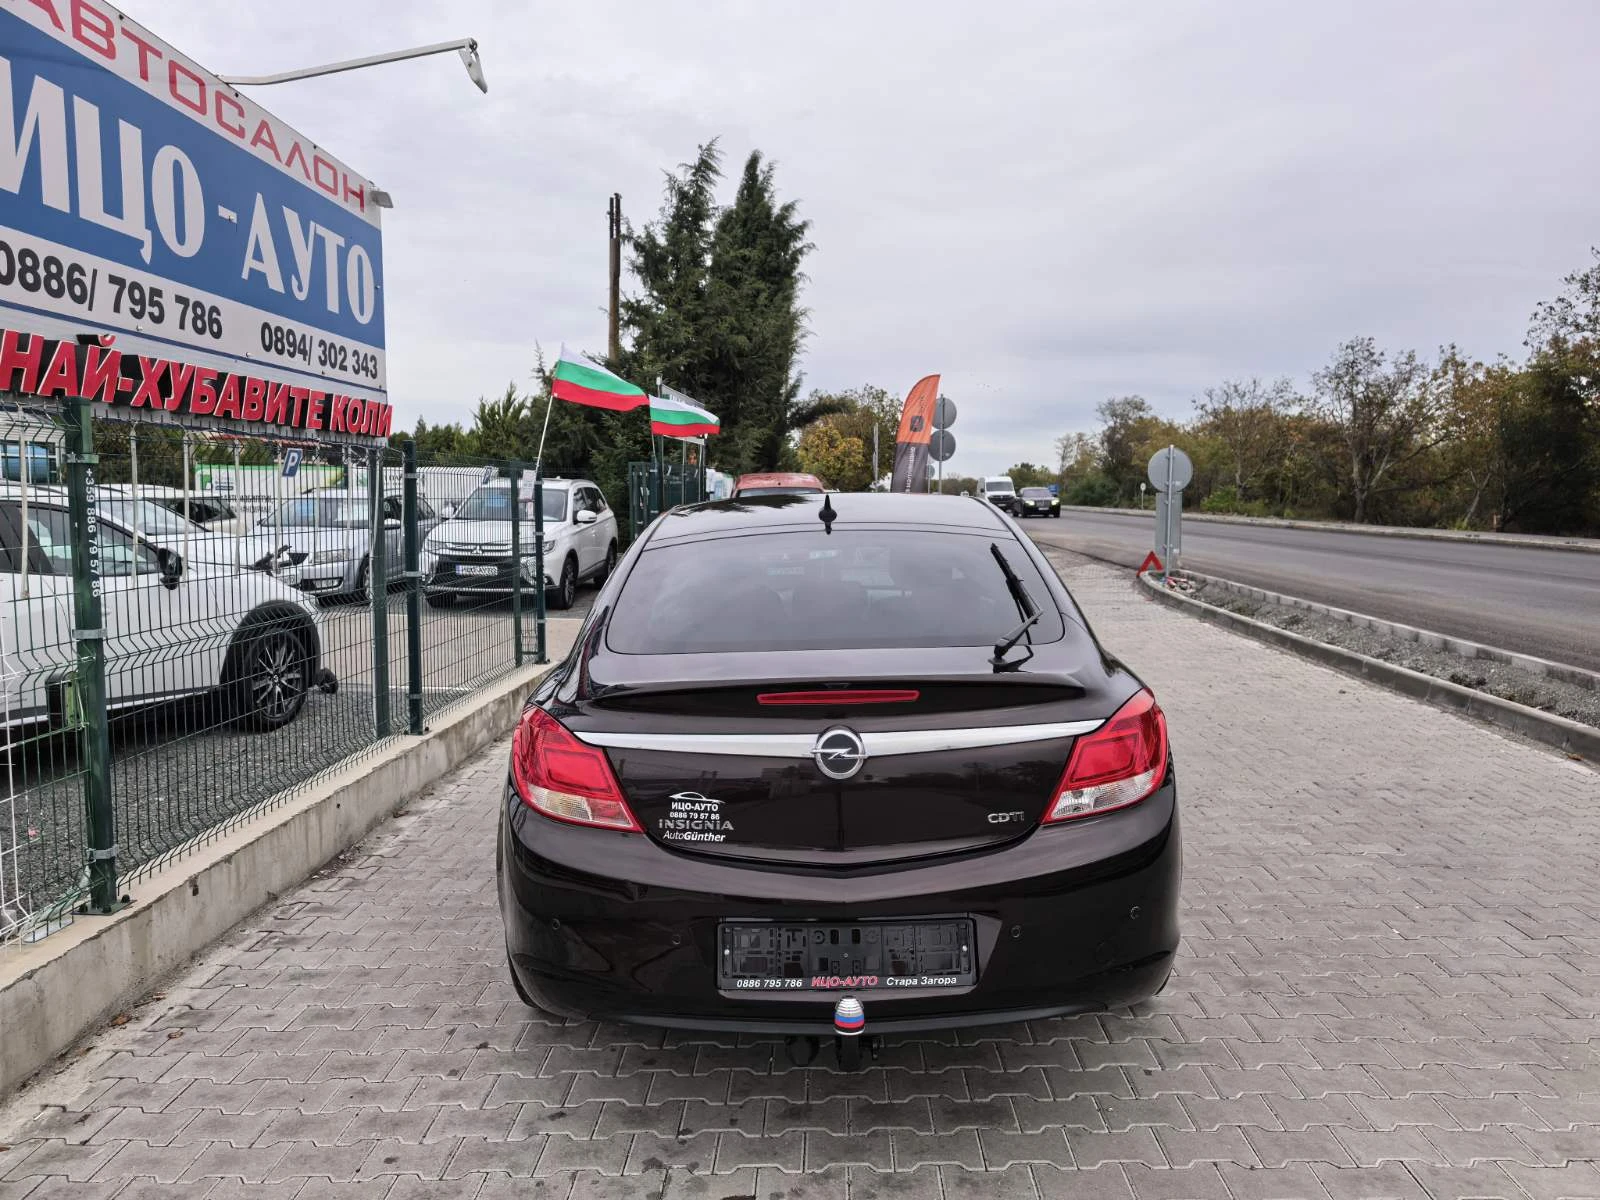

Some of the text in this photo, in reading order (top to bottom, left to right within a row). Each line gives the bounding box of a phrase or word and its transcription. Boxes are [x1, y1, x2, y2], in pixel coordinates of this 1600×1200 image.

[108, 274, 165, 325] 795
[174, 295, 223, 340] 786
[260, 321, 313, 367] 0894/
[318, 339, 348, 372] 302
[351, 349, 379, 380] 343
[0, 328, 394, 438] НАЙ-ХУБАВИТЕ КОЛИ
[85, 467, 101, 598] +359 886 79 57 86
[662, 830, 726, 842] AutoGünther
[671, 801, 719, 812] ИЦО-АУТО
[736, 976, 957, 989] 0886 795 786 ИЦО-АУТО Стара Загора
